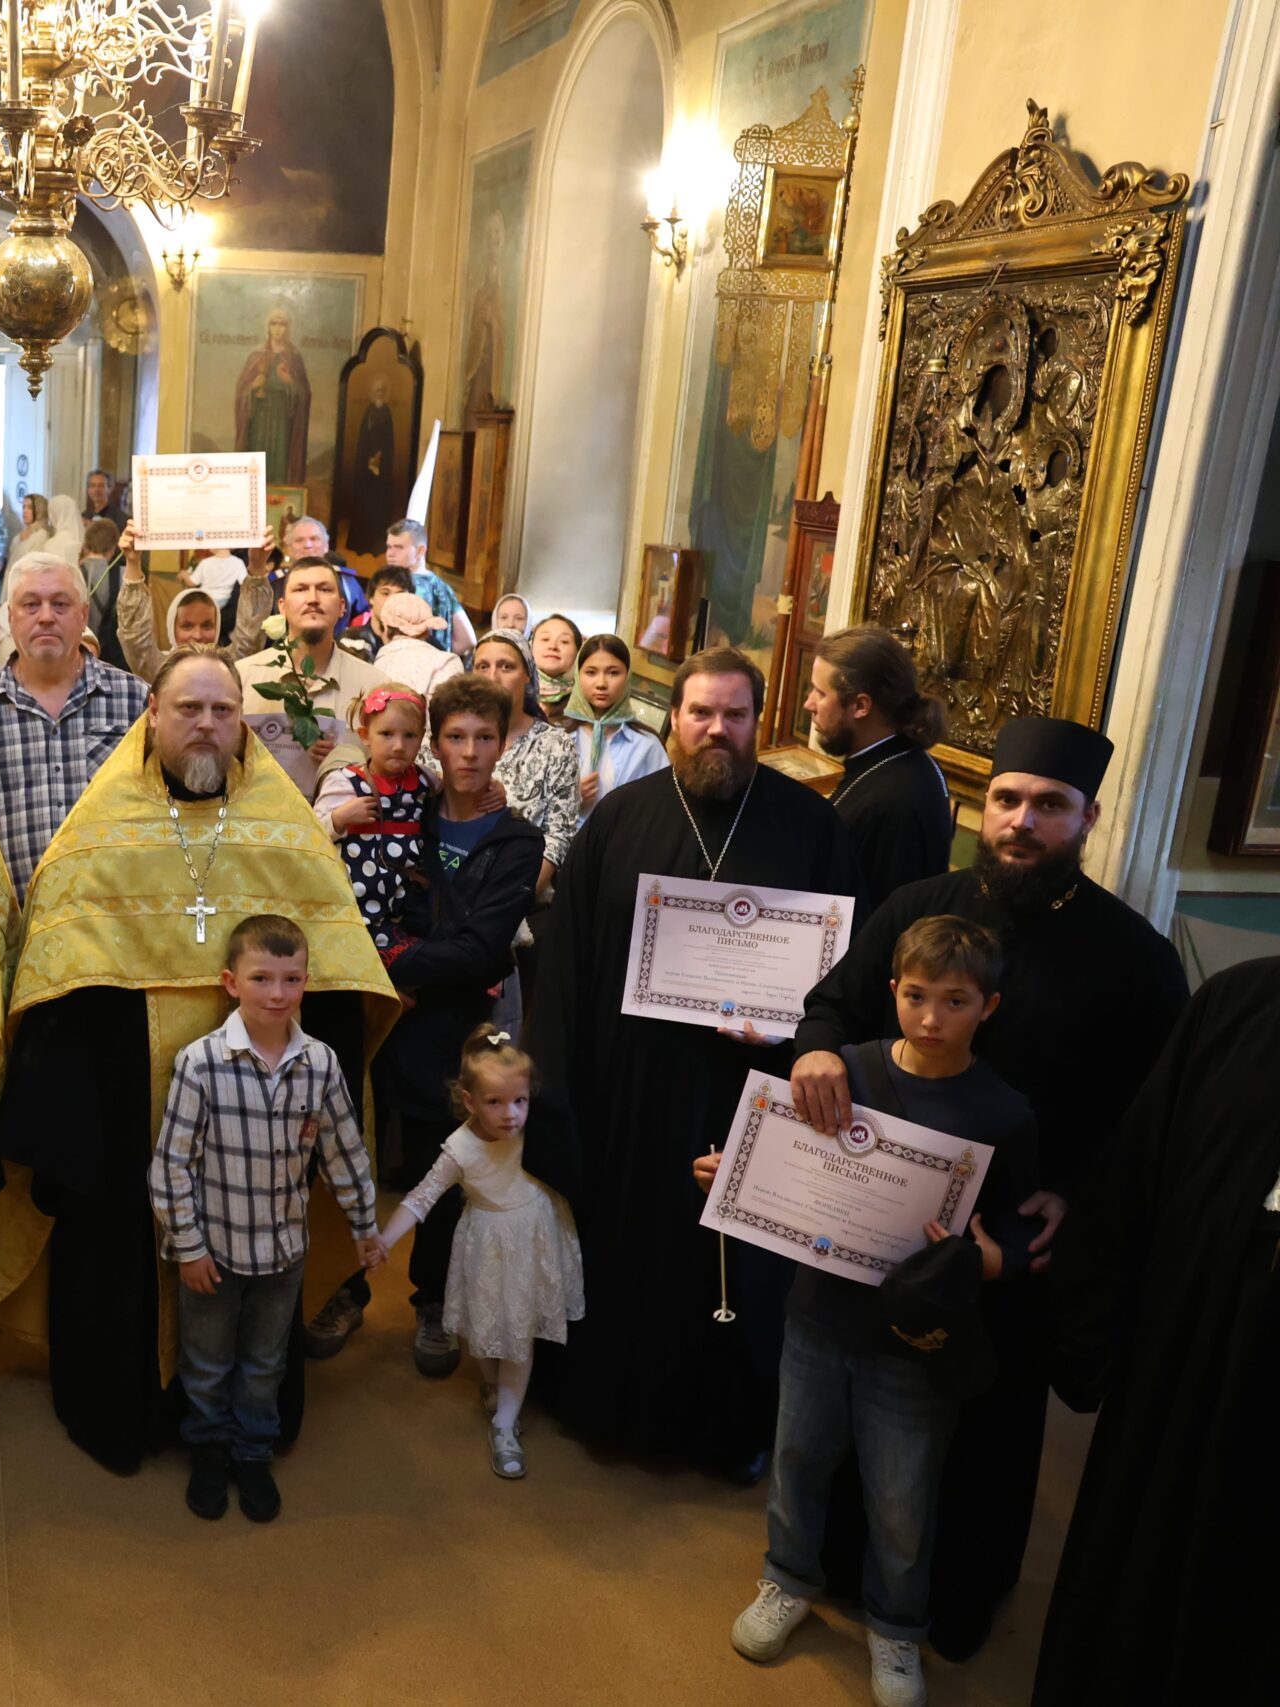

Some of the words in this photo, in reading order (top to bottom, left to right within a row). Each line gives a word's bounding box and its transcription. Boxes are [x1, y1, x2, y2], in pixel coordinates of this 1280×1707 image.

[687, 923, 790, 945] БЛАГОДАРСТВЕННОЕ
[716, 936, 759, 949] ПИСЬМО
[790, 1139, 910, 1188] БЛАГОДАРСТВЕННОЕ
[821, 1160, 871, 1185] ПИСЬМО
